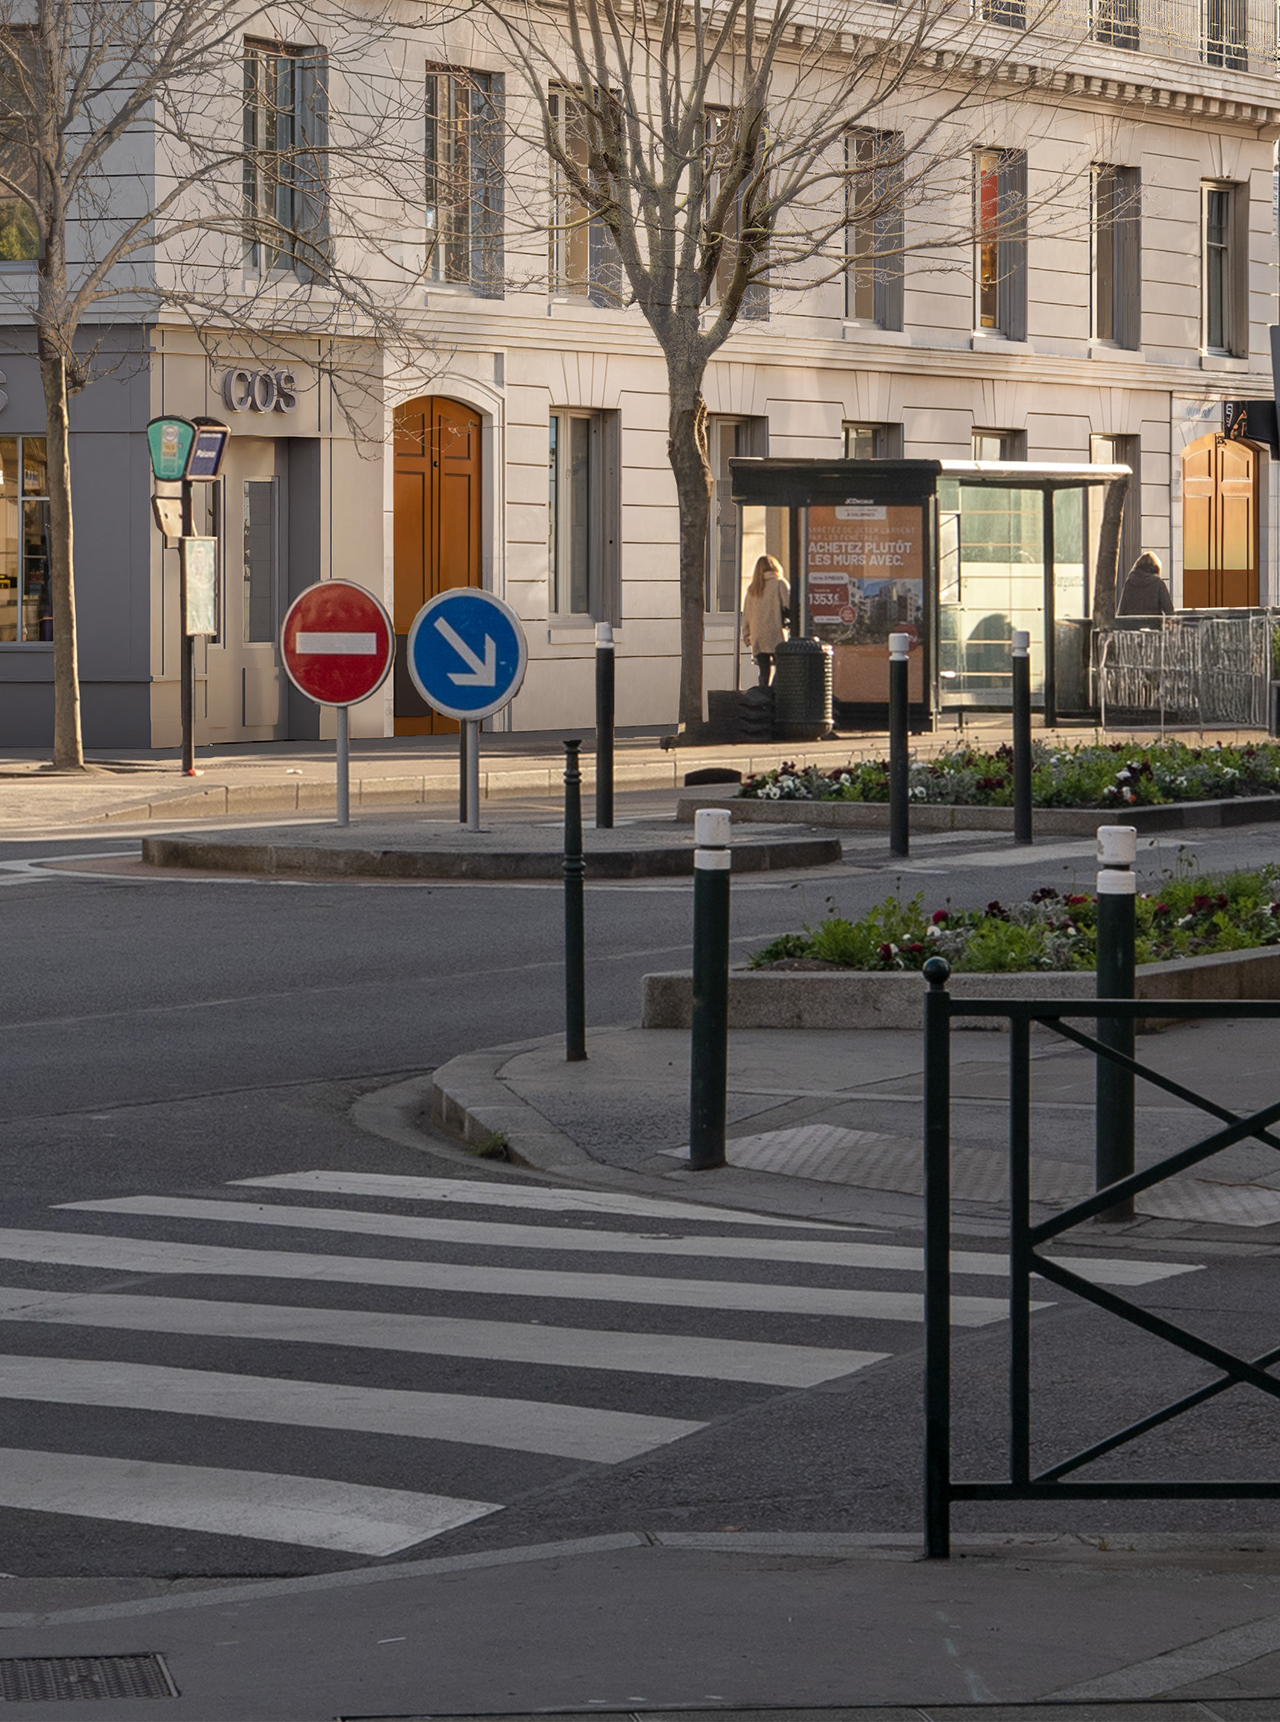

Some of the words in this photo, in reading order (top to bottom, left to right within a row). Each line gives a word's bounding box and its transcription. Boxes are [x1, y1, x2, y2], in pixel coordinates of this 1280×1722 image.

[224, 368, 300, 415] COS
[808, 542, 862, 553] ACHETEZ
[865, 539, 912, 553] PLUTÔT
[808, 555, 831, 566] LES
[833, 555, 866, 566] MURS
[869, 555, 905, 566] AVEC.
